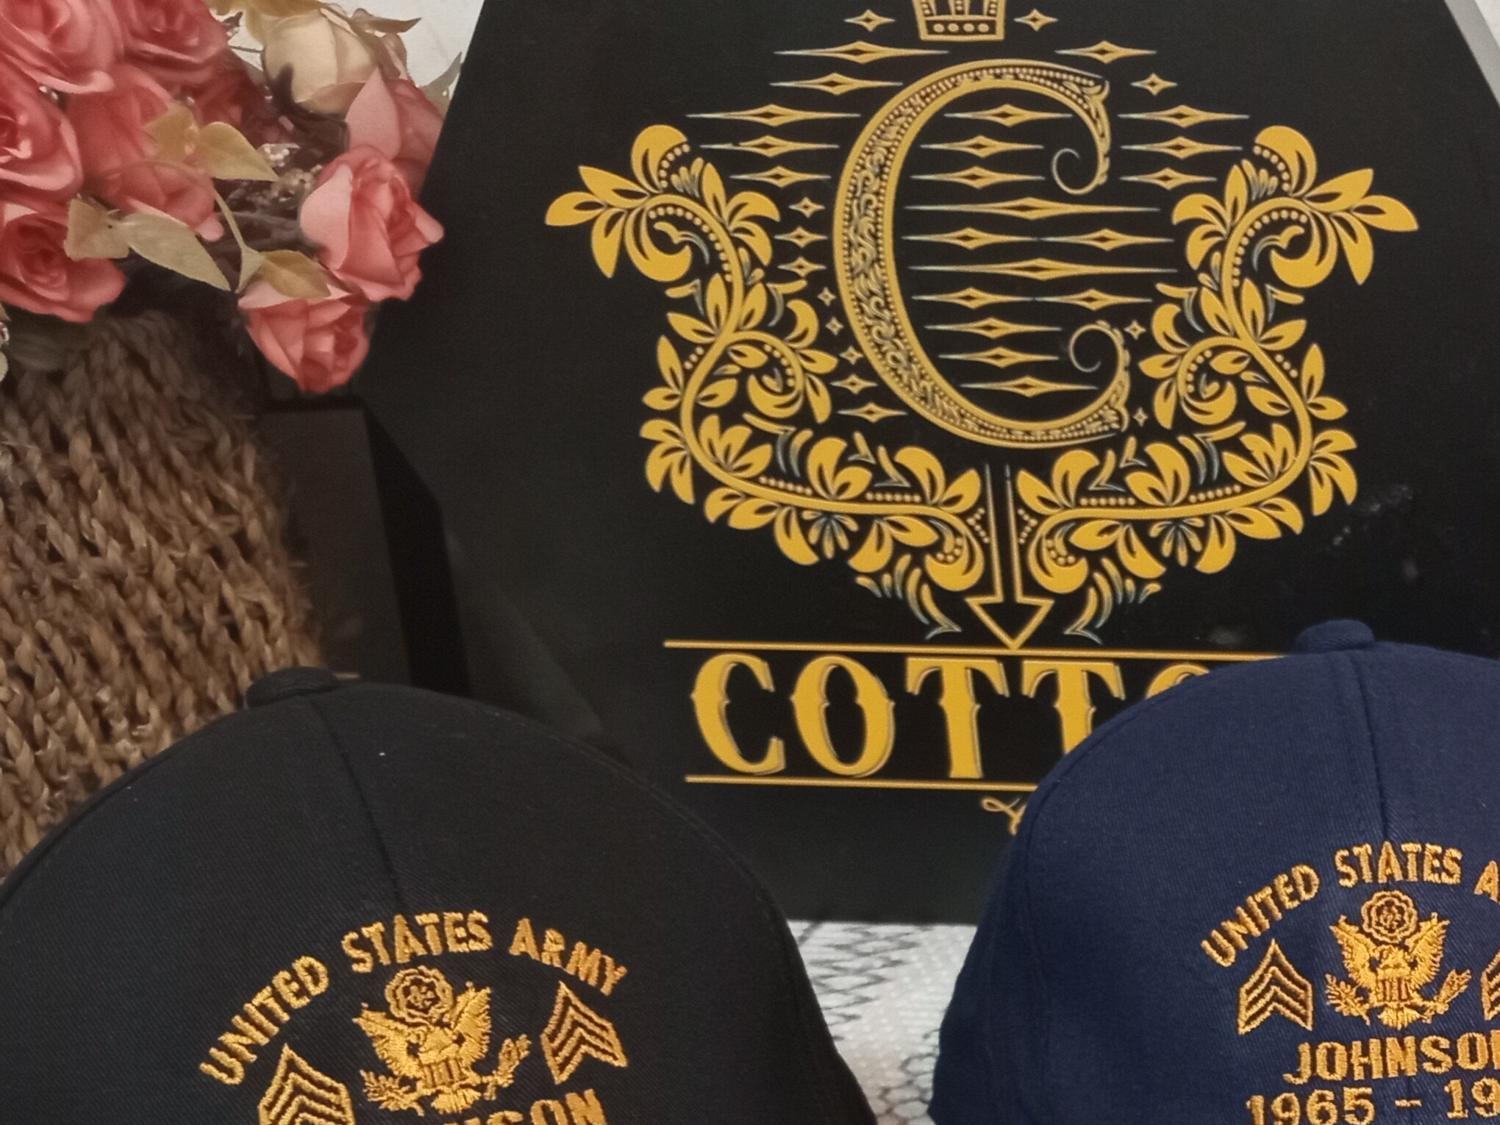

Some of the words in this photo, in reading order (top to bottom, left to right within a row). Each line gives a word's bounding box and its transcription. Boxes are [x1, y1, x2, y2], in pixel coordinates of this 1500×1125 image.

[690, 652, 1210, 778] COTT
[1201, 863, 1320, 968] UNITED
[1334, 841, 1463, 887] STATES
[200, 955, 330, 1086] UNITED
[341, 910, 493, 974] STATES
[509, 917, 628, 996] ARMY
